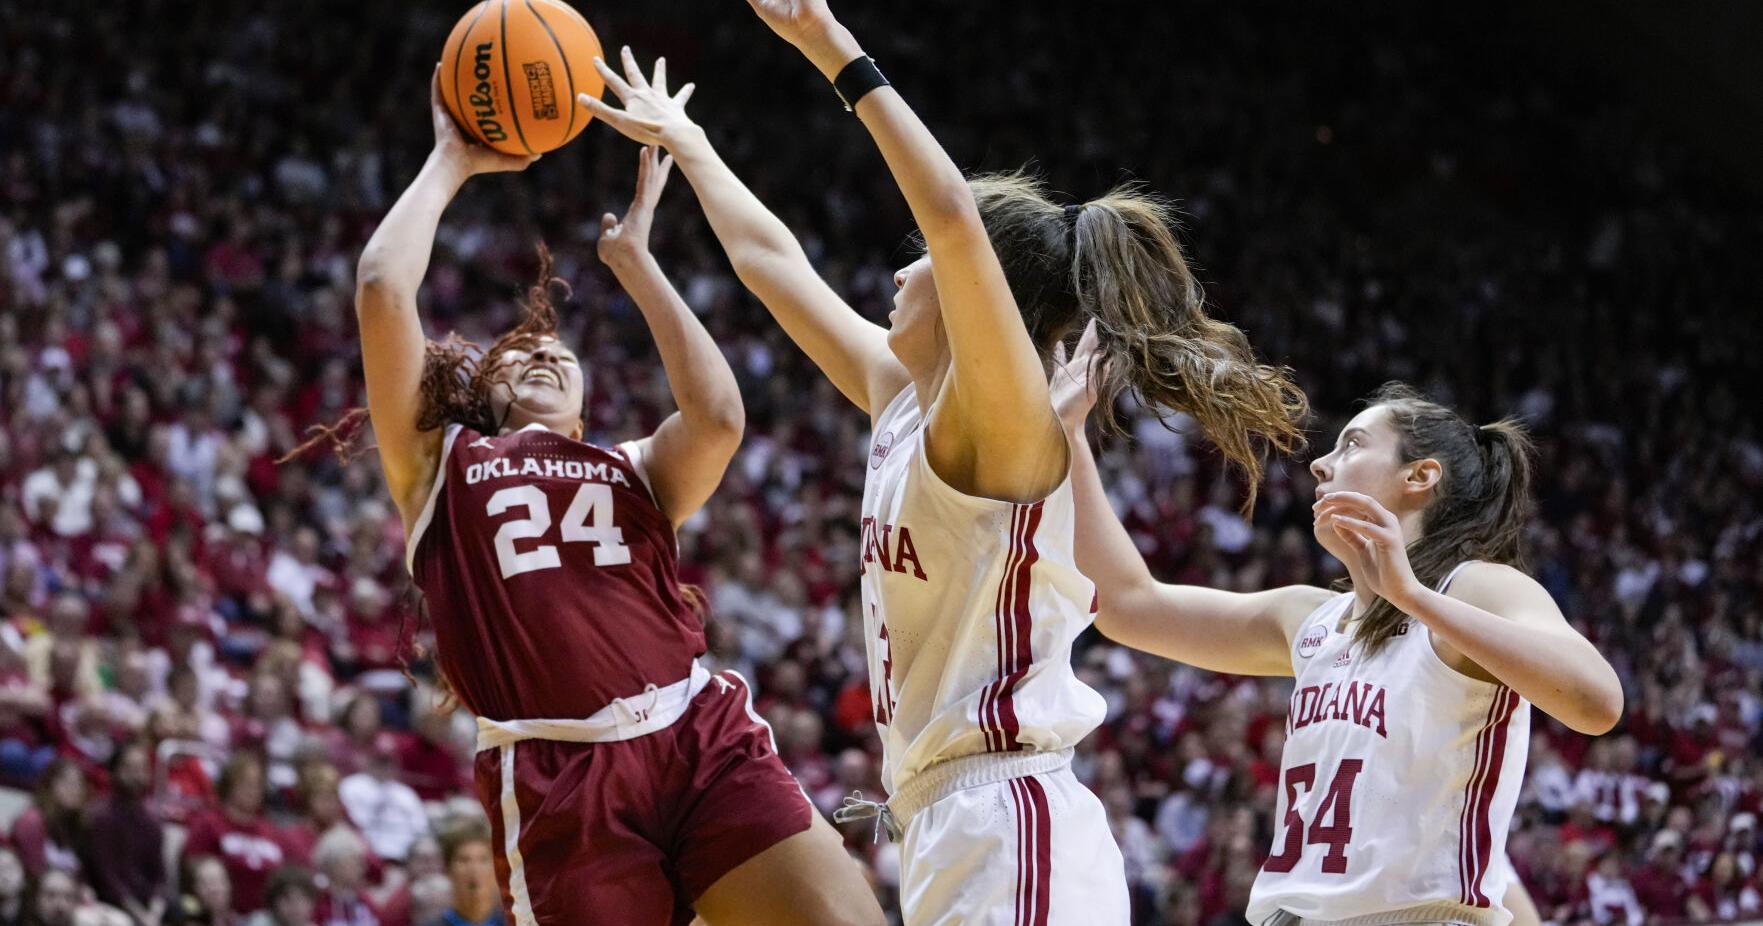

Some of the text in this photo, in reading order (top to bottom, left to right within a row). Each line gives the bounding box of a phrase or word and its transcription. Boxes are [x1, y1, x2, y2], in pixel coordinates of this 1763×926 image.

[468, 41, 508, 143] Wilson
[465, 457, 631, 488] OKLAHOMA
[486, 483, 632, 580] 24
[1301, 637, 1324, 649] RMK
[1284, 680, 1387, 740] NDIANA
[1263, 758, 1363, 874] 54
